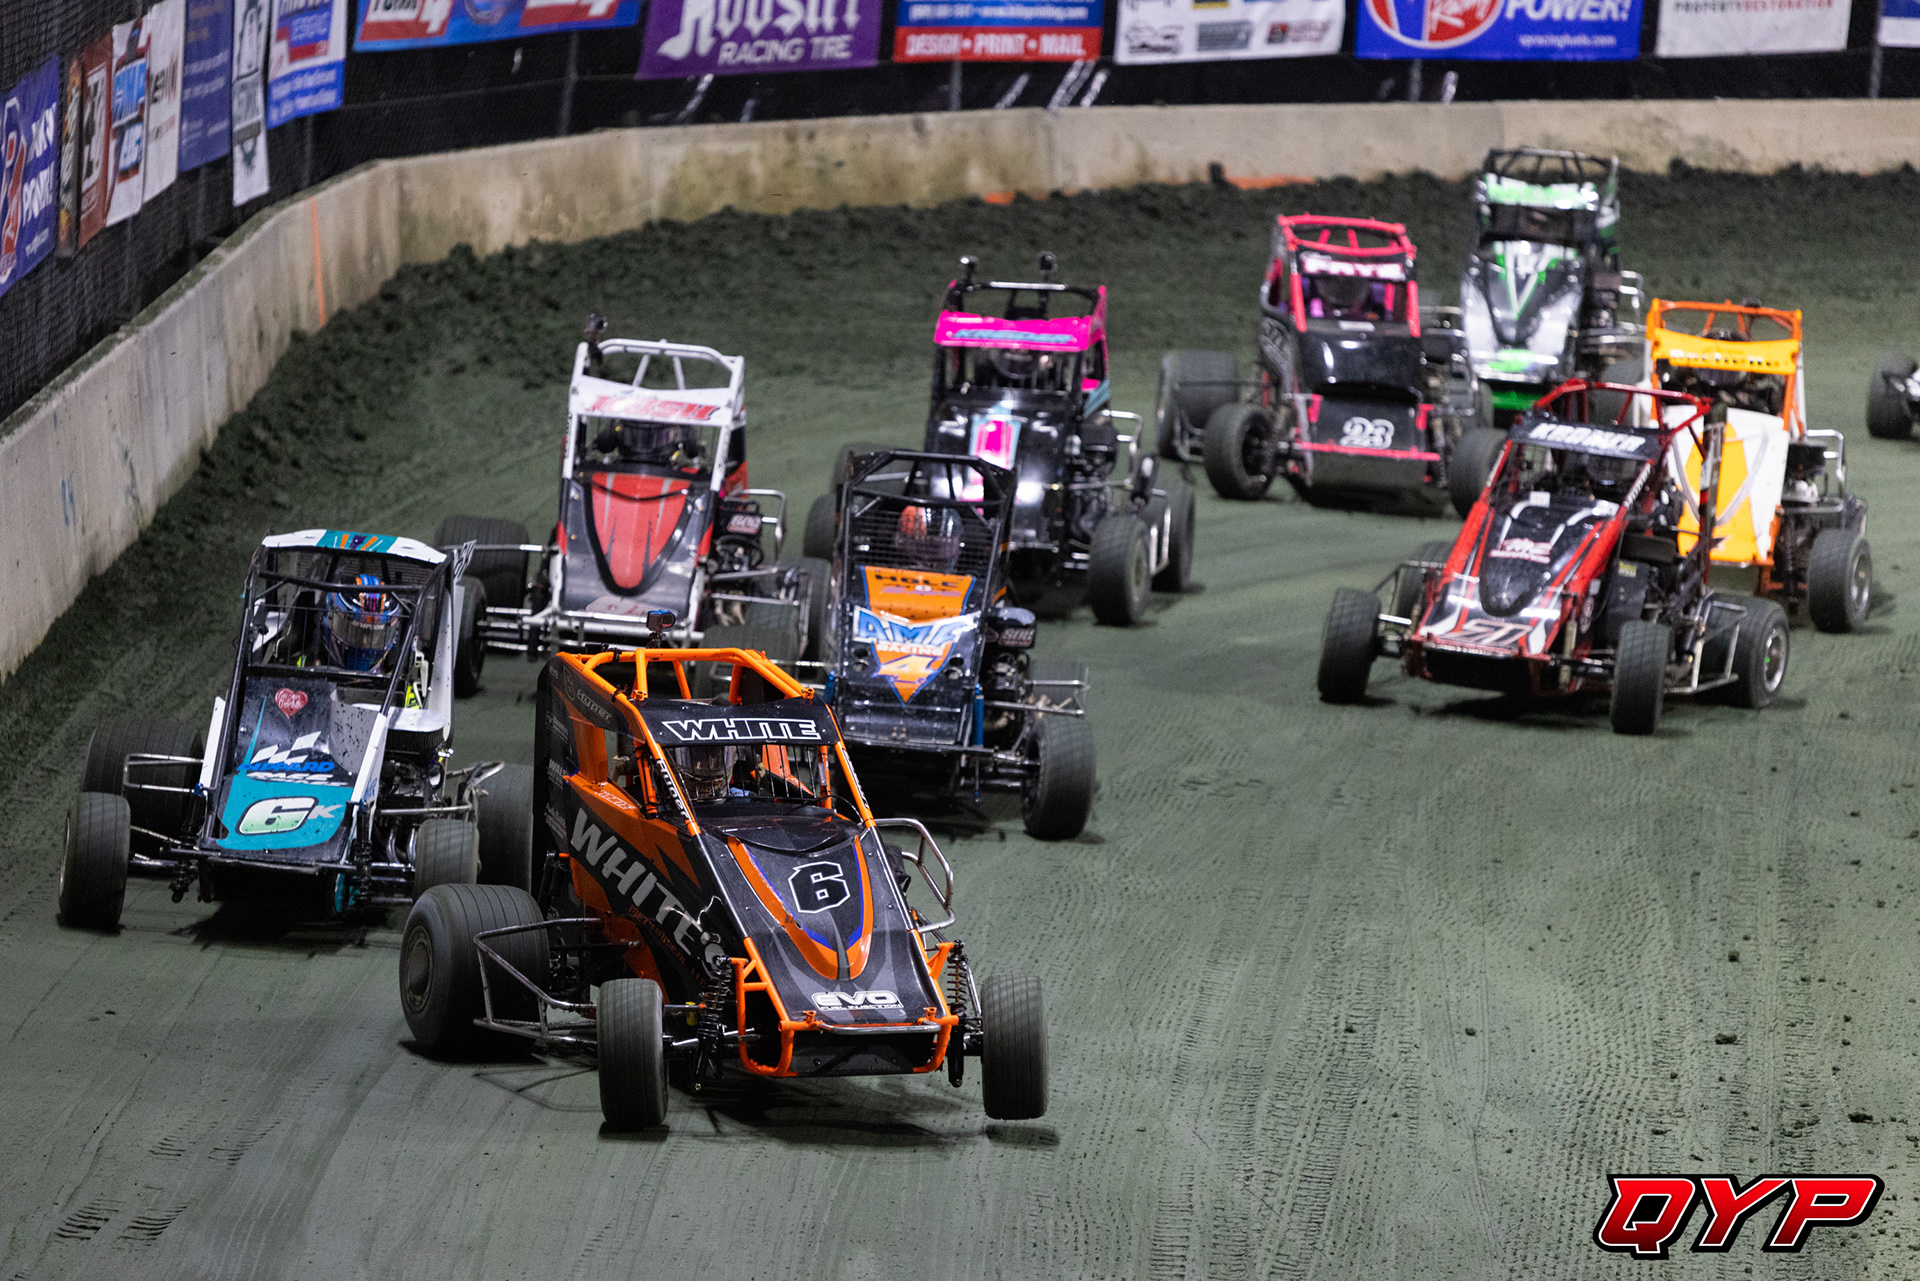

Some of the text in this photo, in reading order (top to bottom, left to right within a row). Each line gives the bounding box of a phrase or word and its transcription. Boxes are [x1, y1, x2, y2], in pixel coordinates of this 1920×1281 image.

[717, 38, 806, 66] RACING
[973, 33, 1028, 56] PRINT
[1340, 416, 1395, 450] 23
[662, 717, 822, 741] WHITE
[788, 861, 850, 913] 6
[812, 990, 899, 1006] EVO
